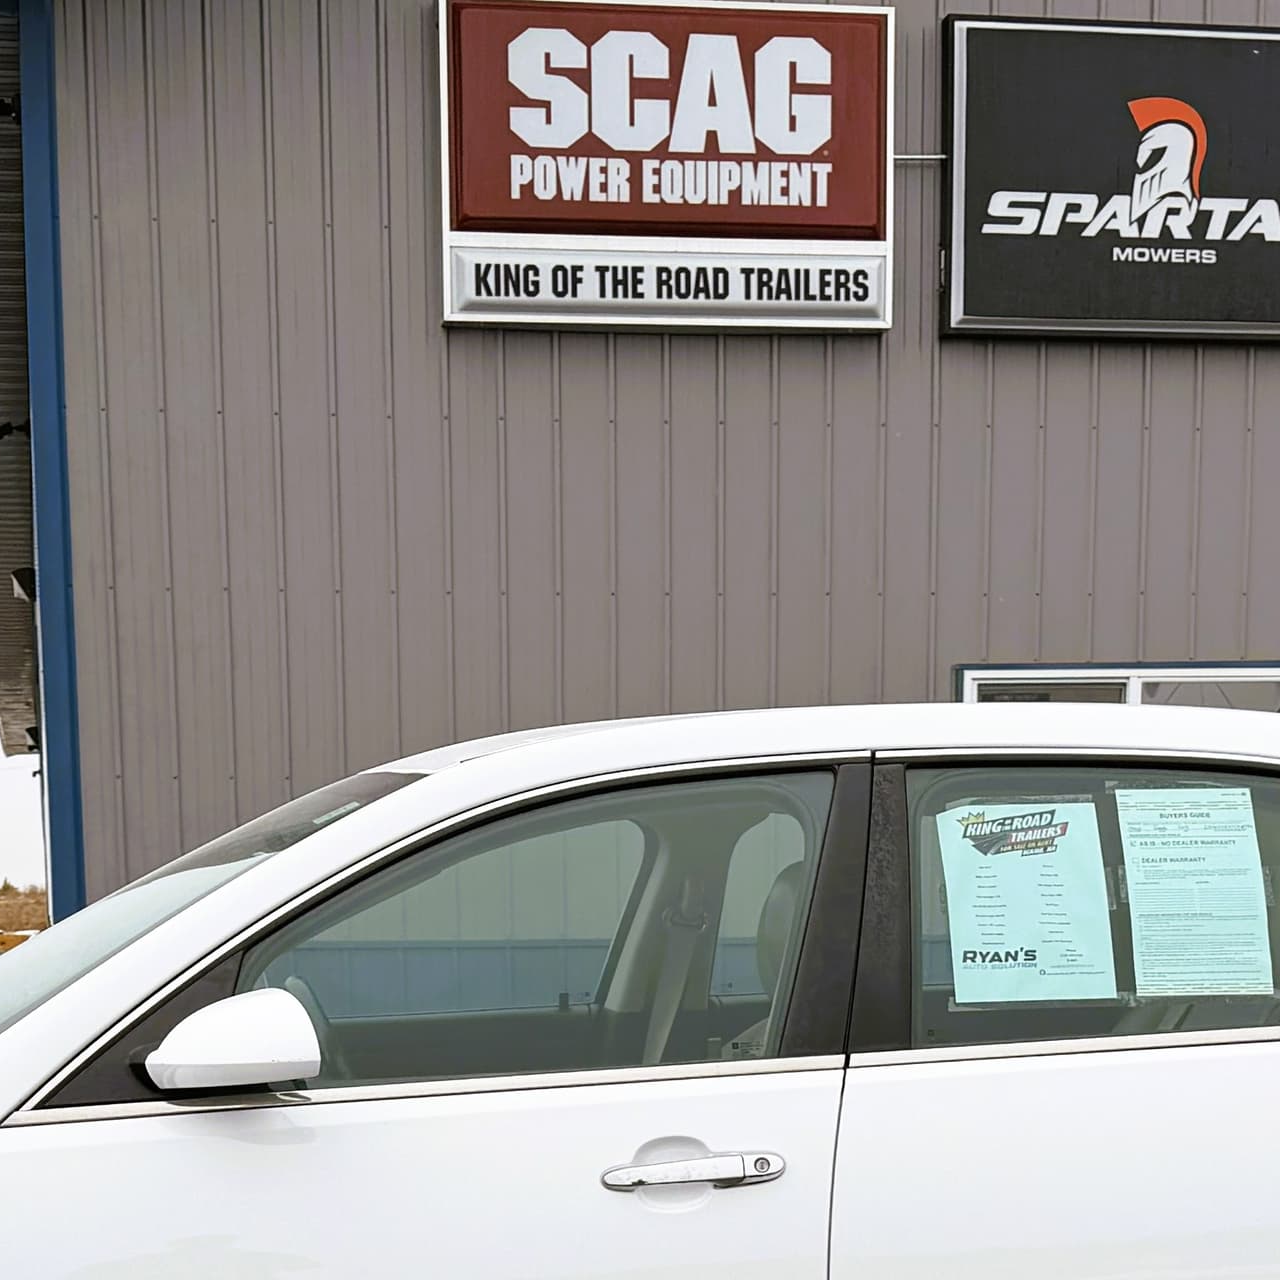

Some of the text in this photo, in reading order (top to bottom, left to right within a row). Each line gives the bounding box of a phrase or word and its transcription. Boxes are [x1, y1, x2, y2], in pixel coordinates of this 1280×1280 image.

[507, 28, 832, 155] SCAG
[510, 154, 833, 207] POWER EQUIPMENT
[1112, 247, 1217, 264] MOWERS
[474, 263, 869, 302] KING OF THE ROAD TRAILERS
[966, 820, 1003, 836] KING
[1012, 813, 1051, 830] ROAD
[1011, 825, 1062, 843] TRAILERS
[962, 947, 1037, 963] RYAN'S
